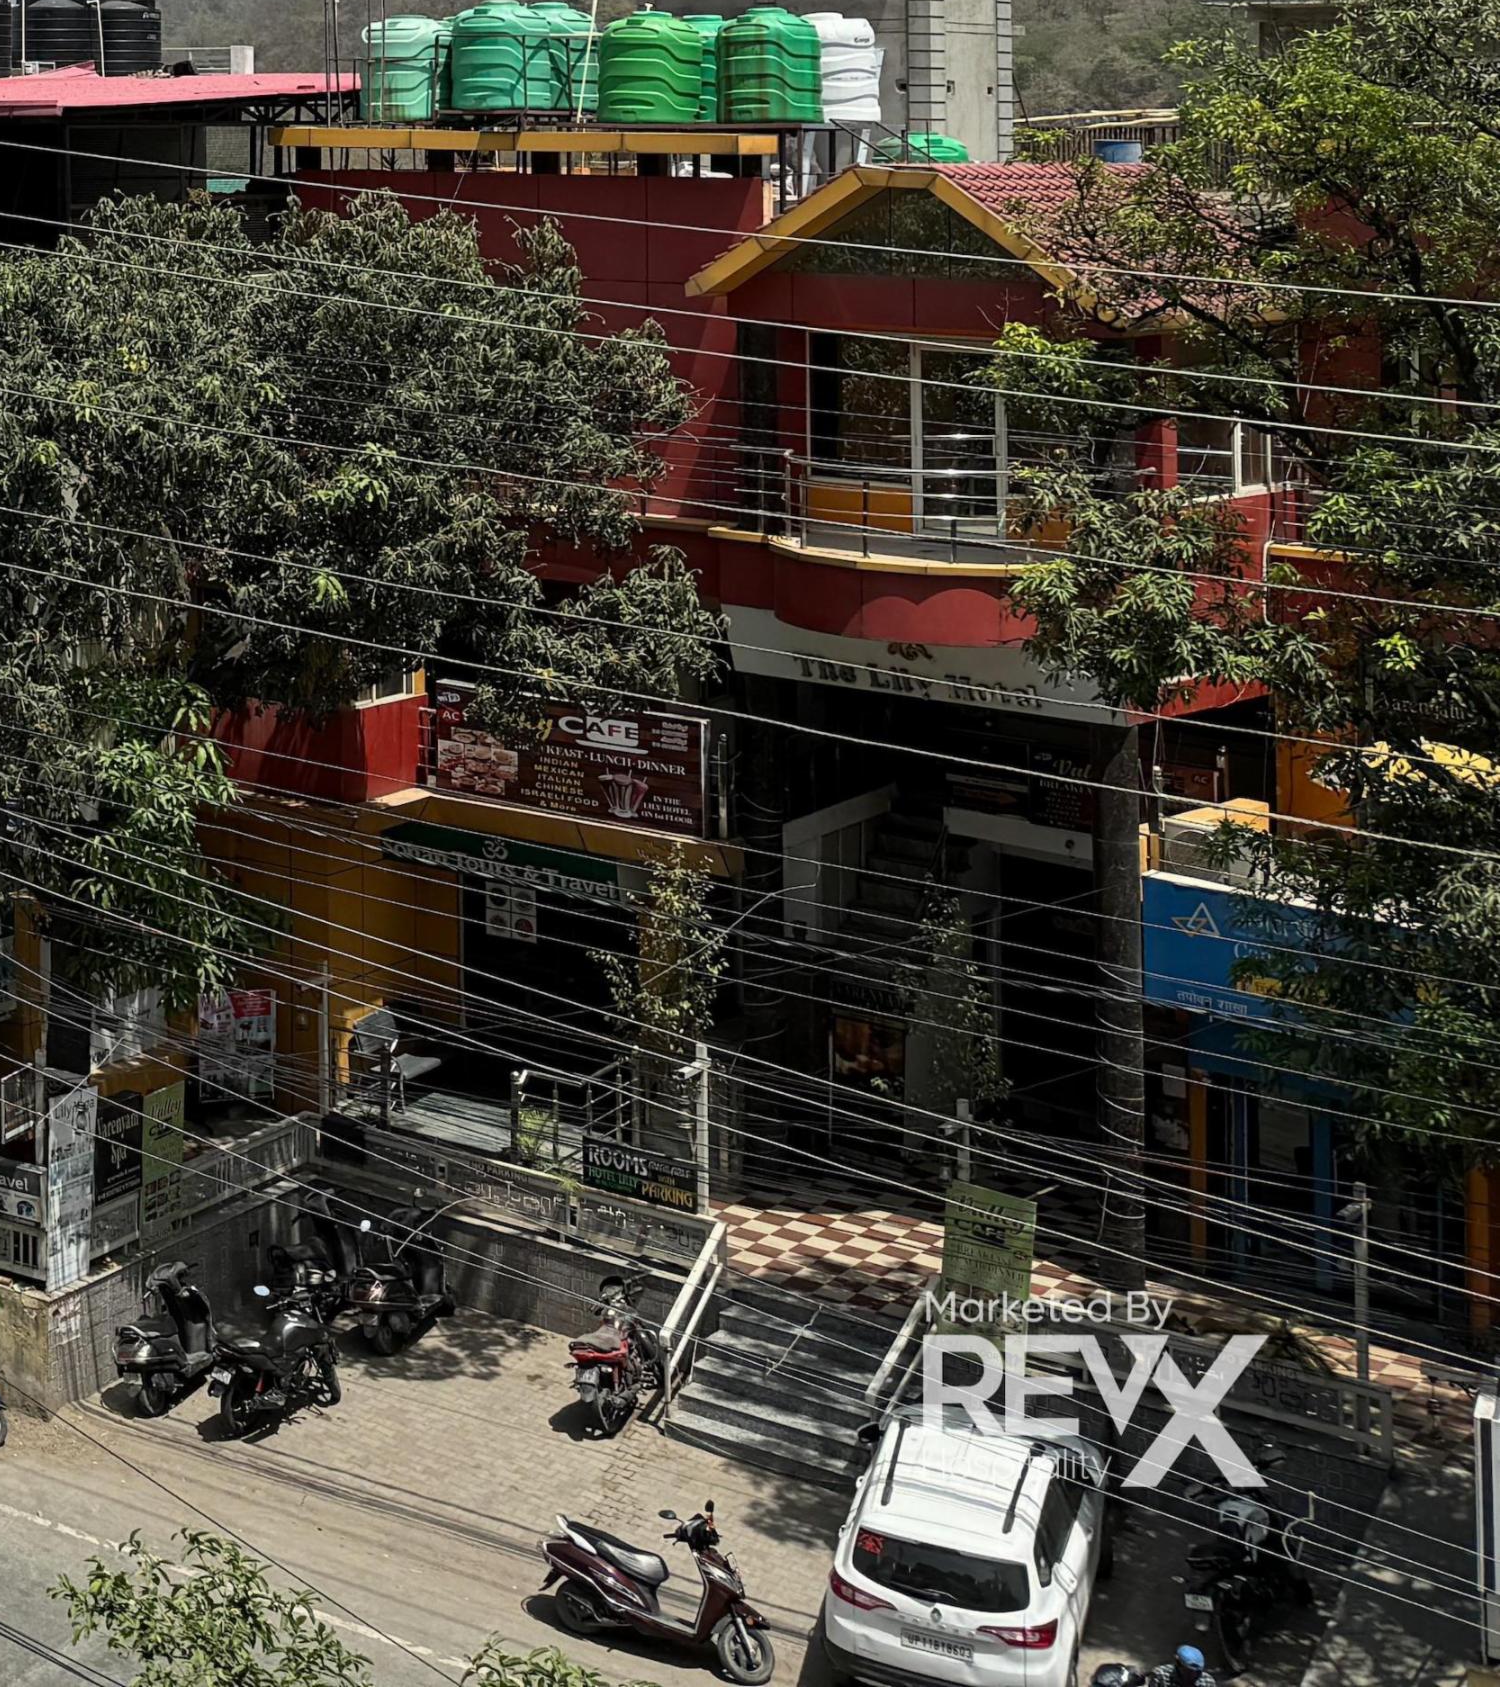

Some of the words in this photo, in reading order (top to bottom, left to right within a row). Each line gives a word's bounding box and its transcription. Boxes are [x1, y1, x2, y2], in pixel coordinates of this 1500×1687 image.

[793, 655, 857, 683] The
[866, 662, 935, 702] Lily
[944, 673, 1043, 708] Hotel
[441, 711, 460, 722] AC
[557, 714, 640, 749] CAFE
[533, 763, 585, 778] MEXICAN
[539, 756, 579, 769] INDIAN
[589, 751, 632, 767] LUNCH
[637, 760, 687, 776] DINNER
[535, 781, 585, 796] CHINESE
[536, 772, 581, 786] ITALIAN
[520, 787, 566, 803] ISRAELI
[567, 795, 599, 808] FOOD
[540, 800, 547, 808] &
[550, 801, 577, 812] More
[664, 796, 681, 806] THE
[663, 804, 693, 815] HOTEL
[450, 850, 521, 879] Tours
[523, 864, 539, 882] &
[541, 867, 618, 899] Travel
[111, 1144, 127, 1170] Spa
[588, 1143, 649, 1177] ROOMS
[641, 1180, 693, 1209] PARKING
[954, 1217, 1007, 1244] CAFE
